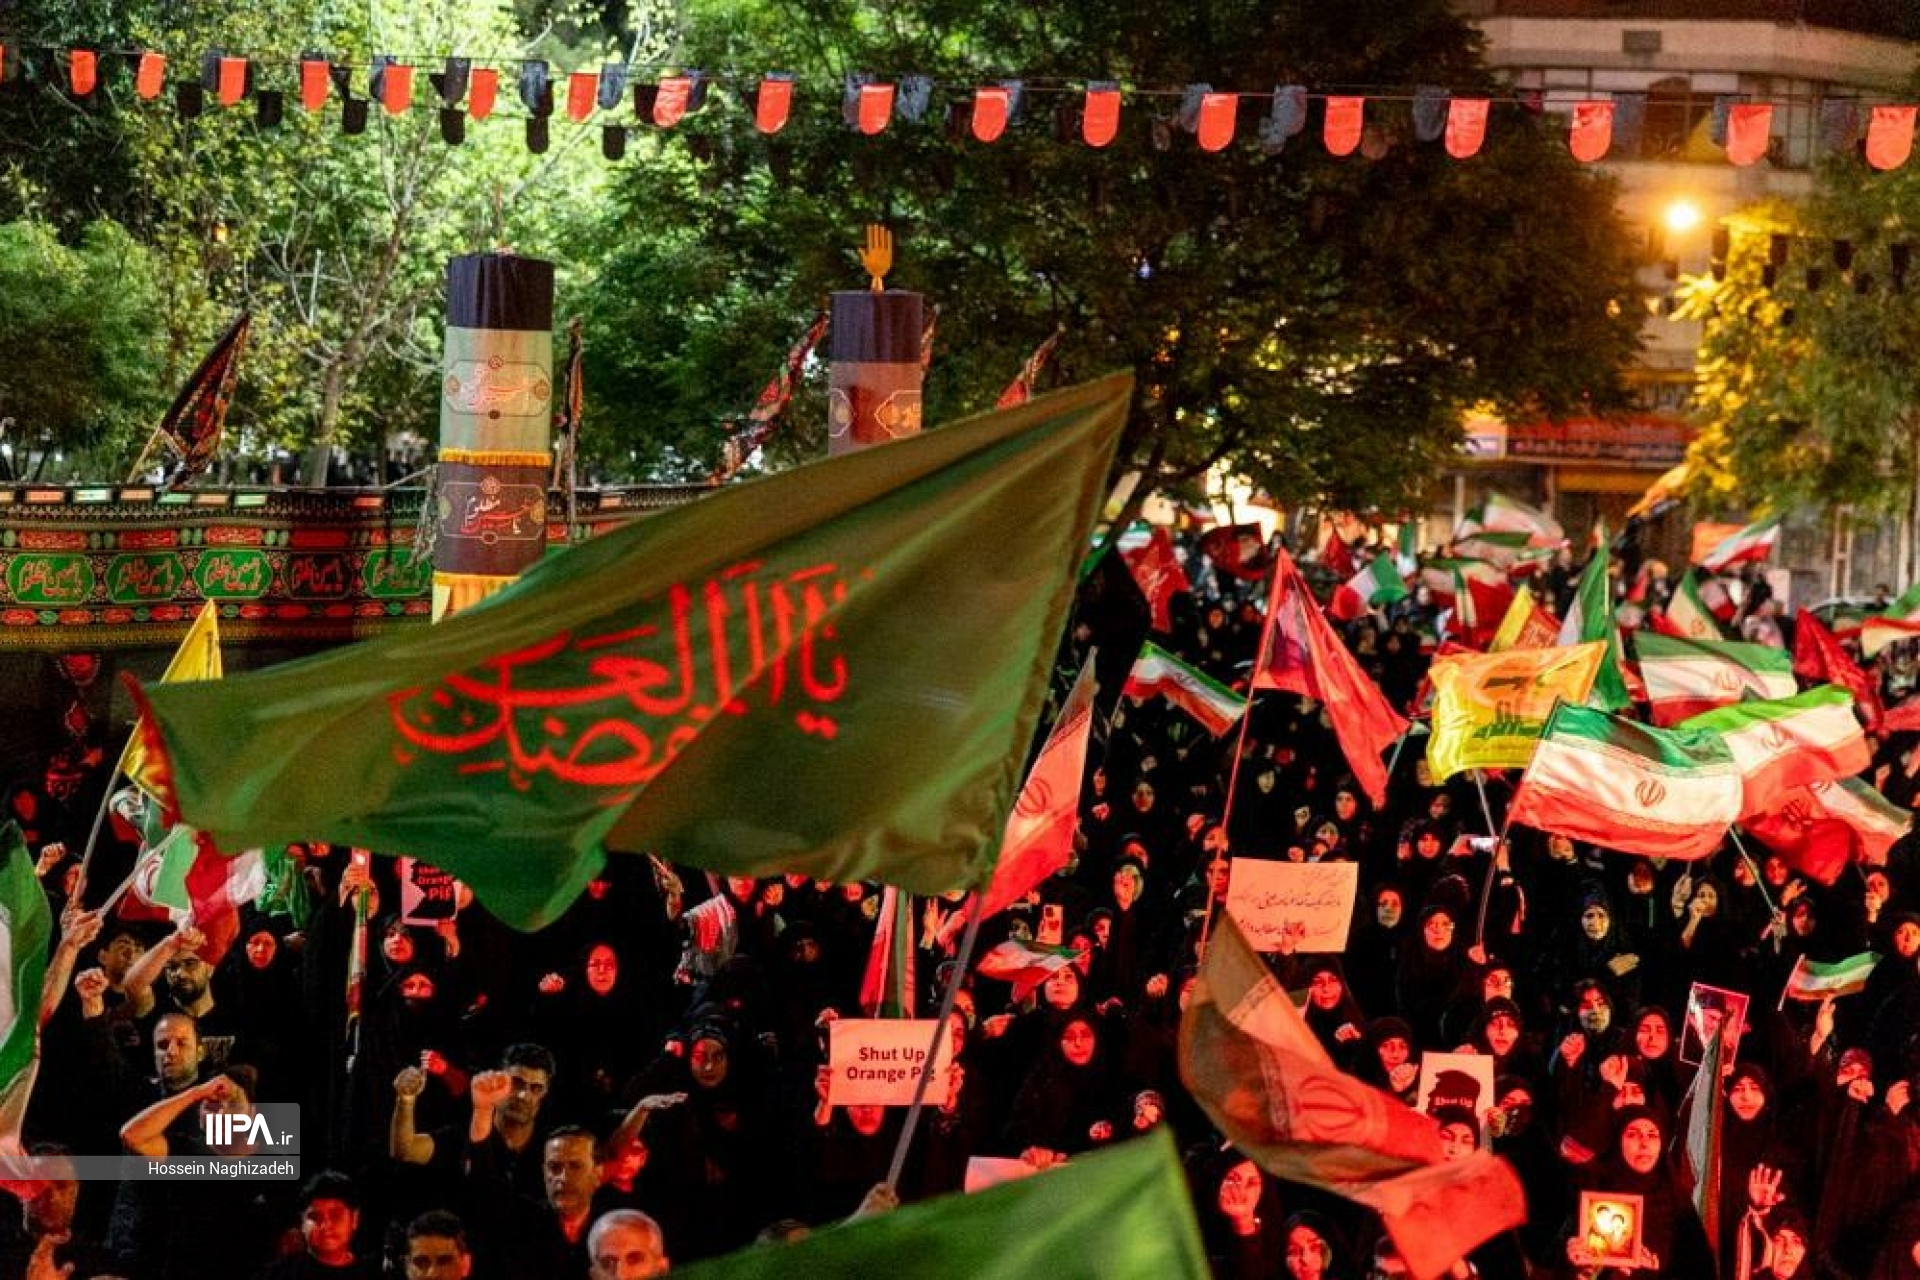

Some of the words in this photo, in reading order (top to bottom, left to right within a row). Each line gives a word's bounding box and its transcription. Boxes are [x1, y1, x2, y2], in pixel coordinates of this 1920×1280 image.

[858, 1046, 898, 1062] Shut
[902, 1046, 926, 1064] Up
[846, 1066, 906, 1083] Orange
